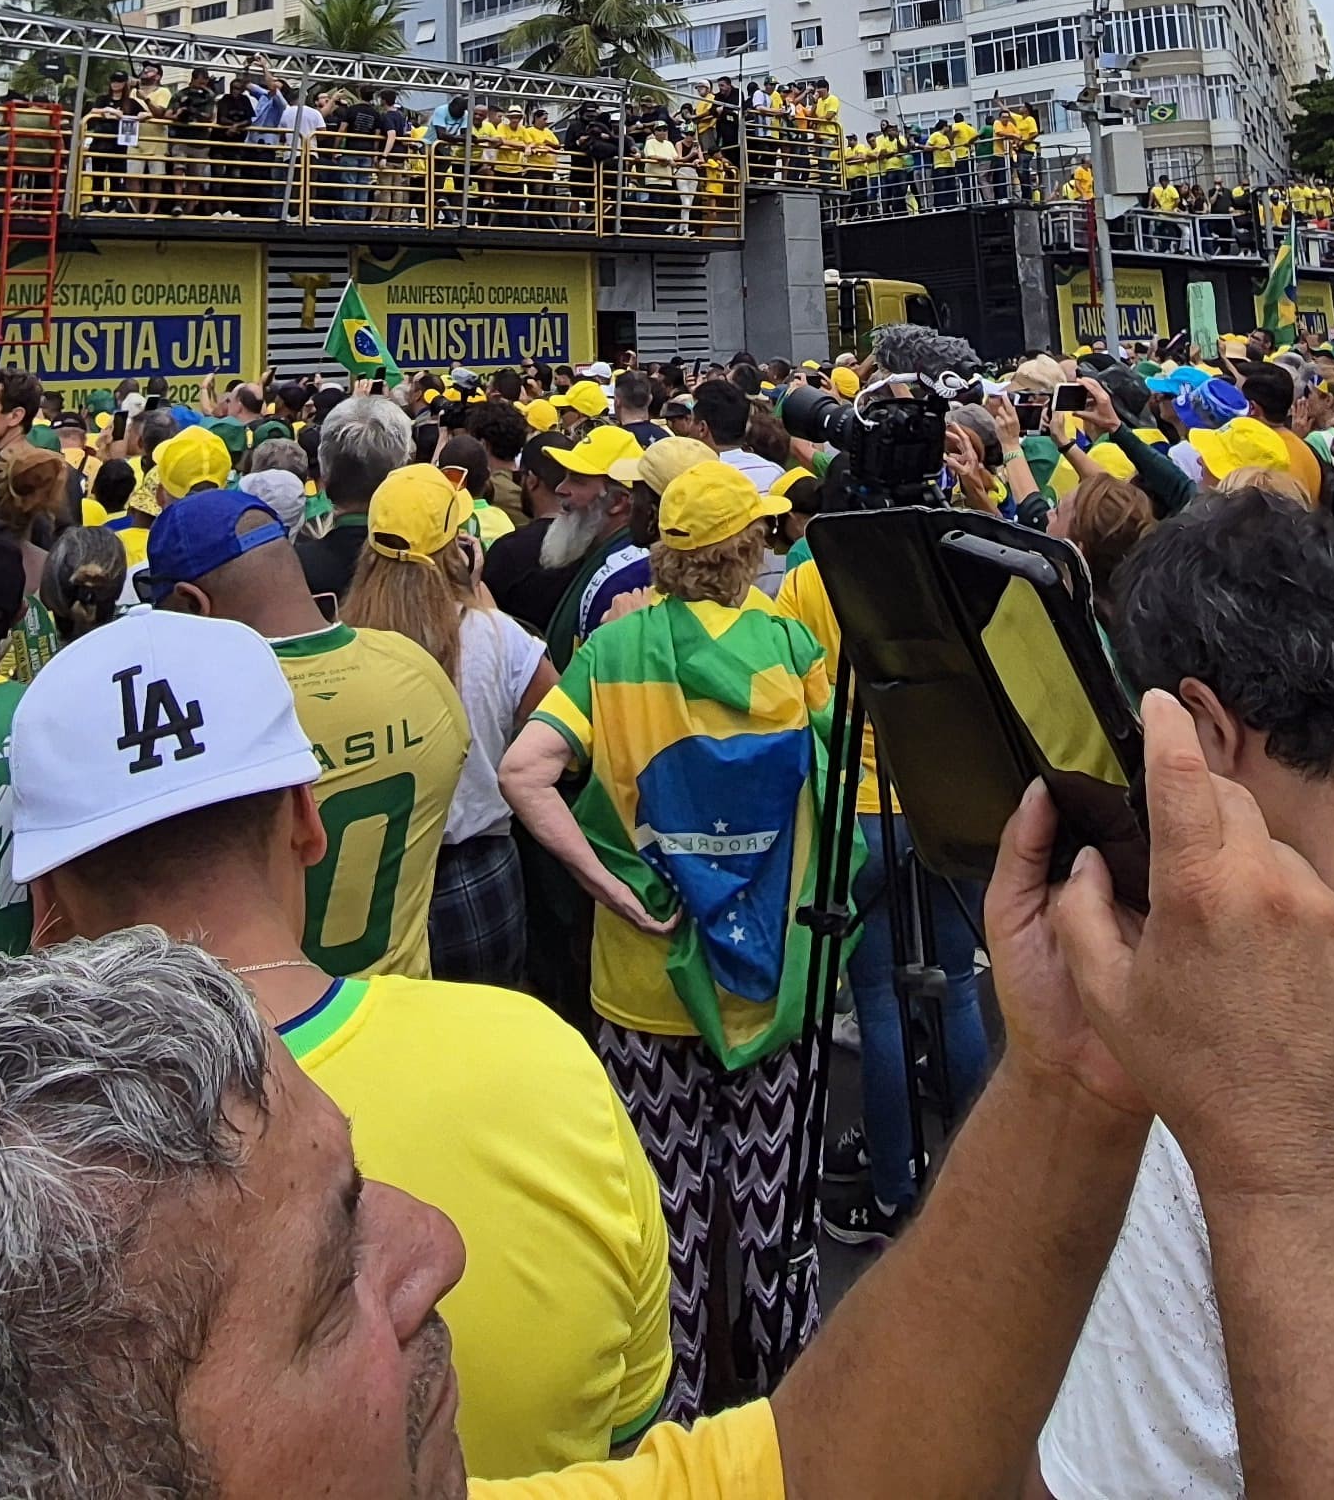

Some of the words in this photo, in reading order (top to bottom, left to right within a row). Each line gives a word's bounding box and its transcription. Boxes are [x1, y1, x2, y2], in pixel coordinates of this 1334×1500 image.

[131, 284, 241, 305] COPACABANA
[387, 282, 483, 309] MANIFESTAÇÃO
[487, 284, 569, 305] COPACABANA
[171, 306, 231, 369] JÁ!
[396, 317, 511, 361] ANISTIA
[518, 306, 562, 358] JÁ!
[112, 664, 206, 774] LA
